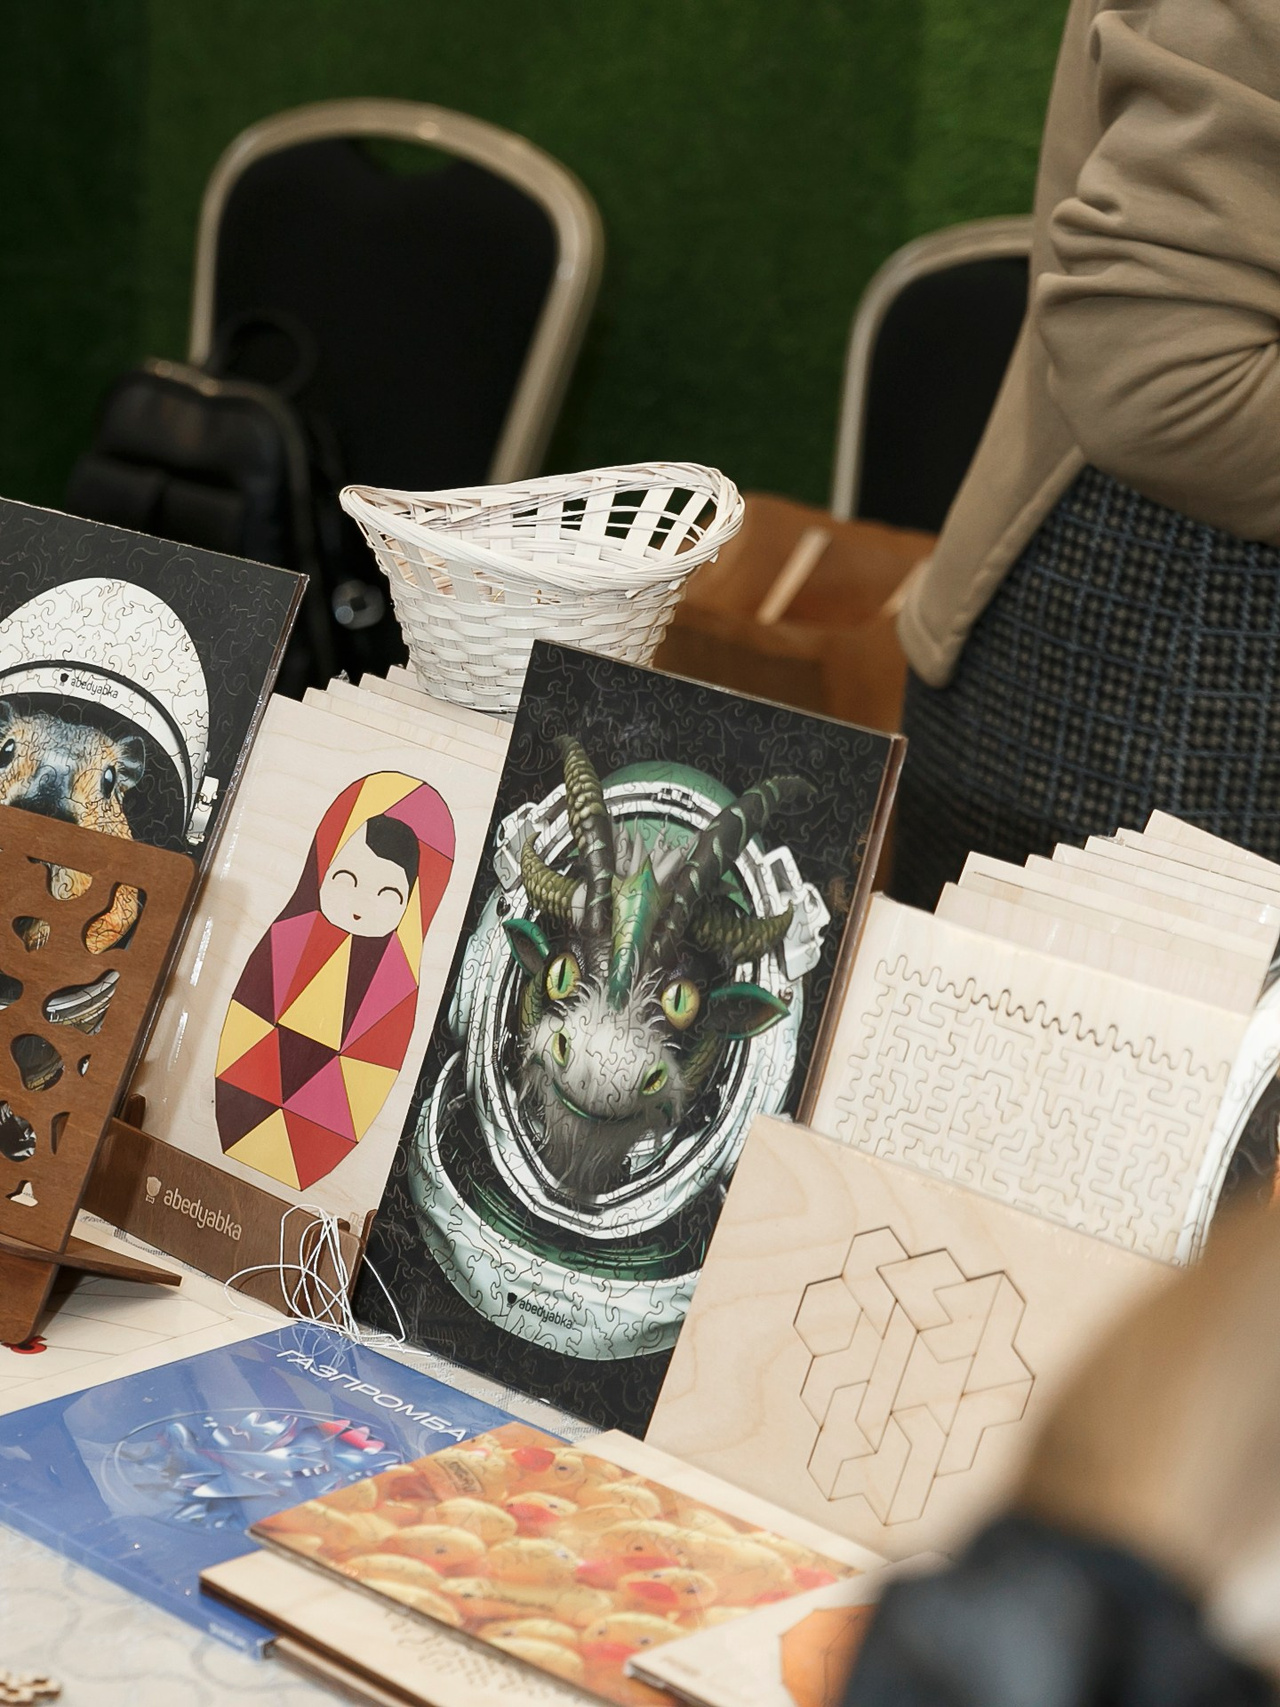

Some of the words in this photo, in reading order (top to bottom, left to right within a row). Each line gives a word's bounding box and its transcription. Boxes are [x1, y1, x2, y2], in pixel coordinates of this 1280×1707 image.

[70, 677, 118, 698] abedyabka
[163, 1188, 242, 1241] abedyabka
[518, 1299, 573, 1330] abedyabka
